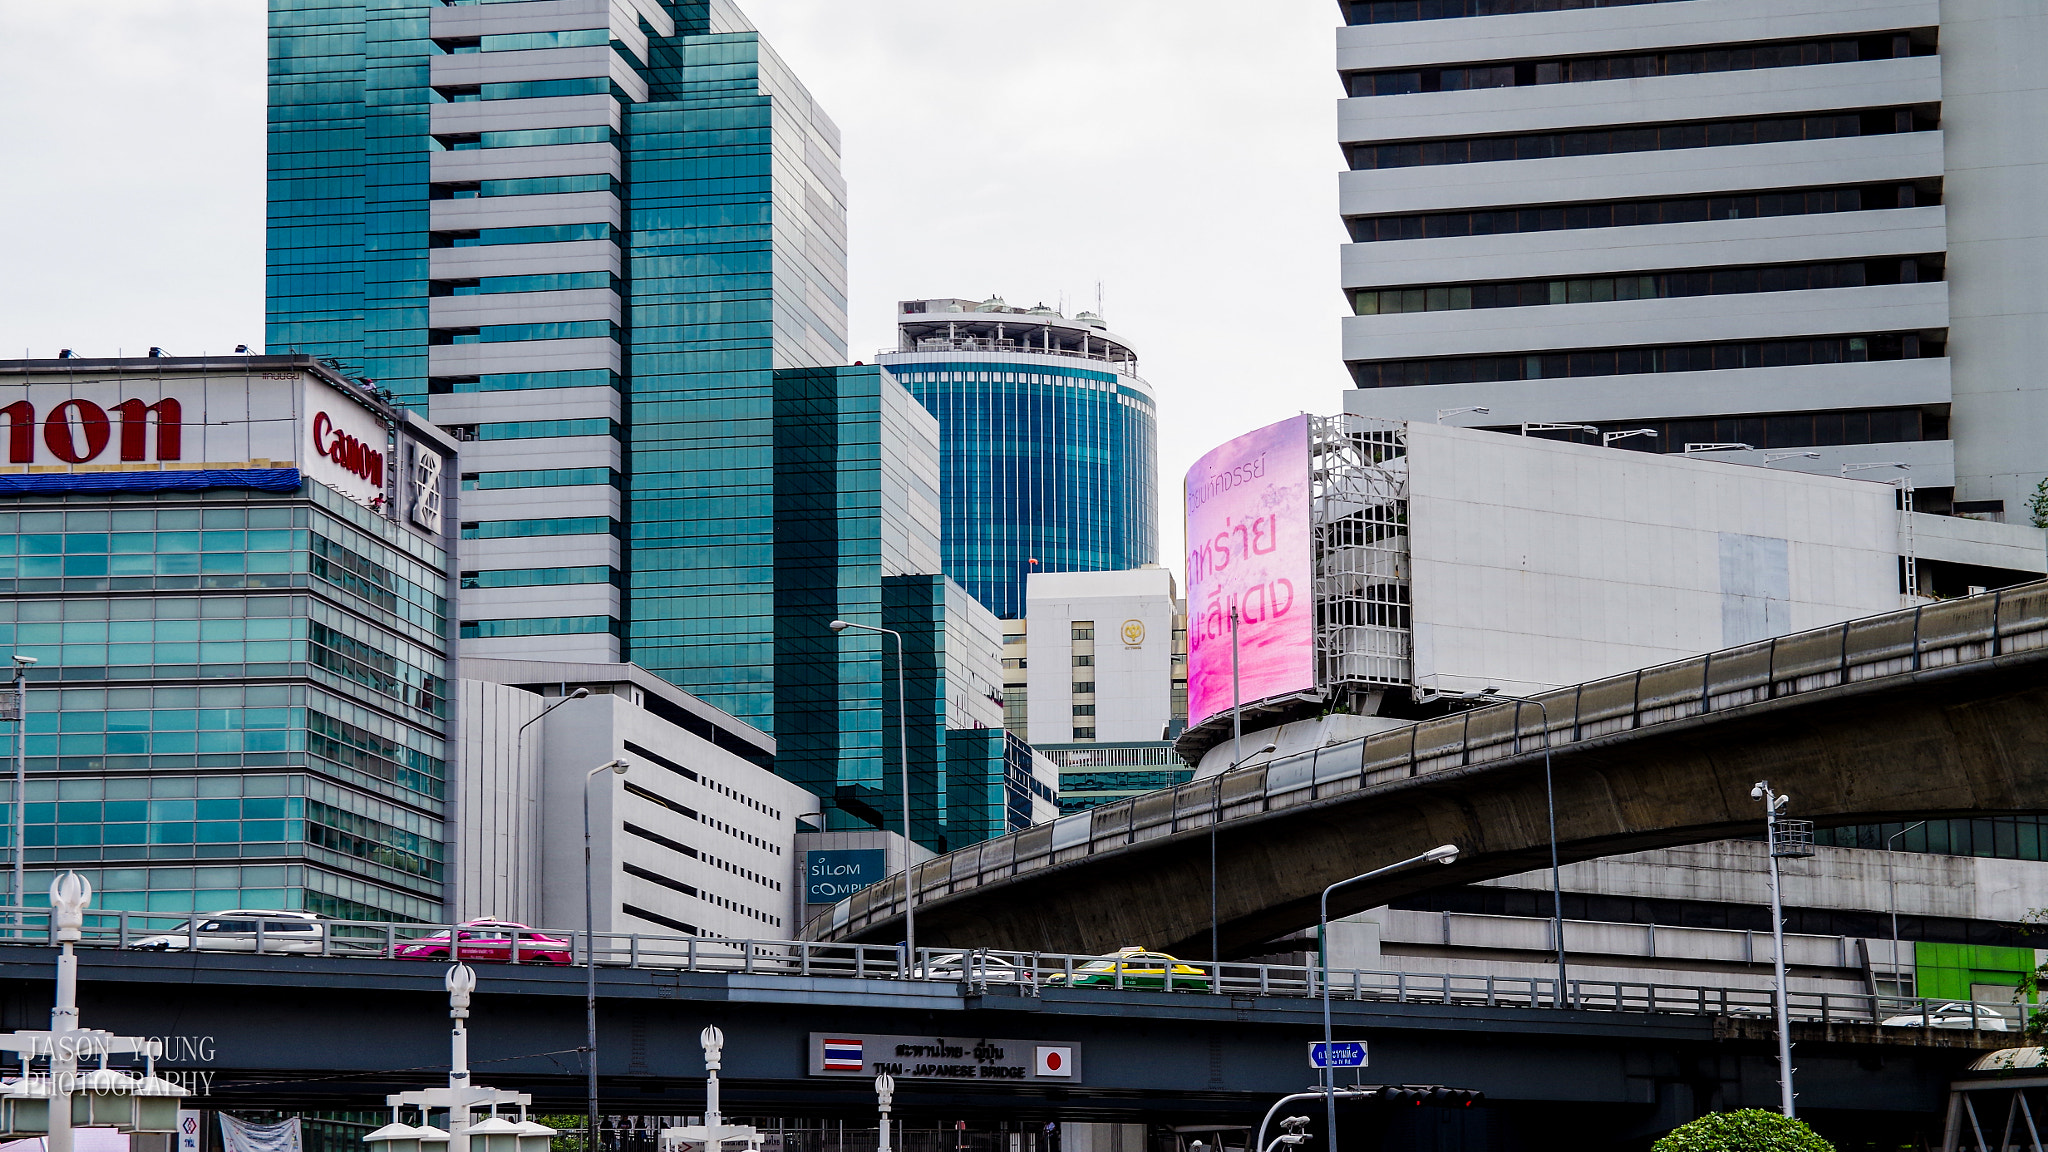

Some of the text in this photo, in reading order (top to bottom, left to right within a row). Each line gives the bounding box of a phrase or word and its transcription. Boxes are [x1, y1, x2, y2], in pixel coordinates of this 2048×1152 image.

[313, 410, 383, 489] Canon
[873, 1062, 903, 1075] THAI
[913, 1063, 977, 1077] JAPANESE
[980, 1066, 1026, 1079] BRIDGE
